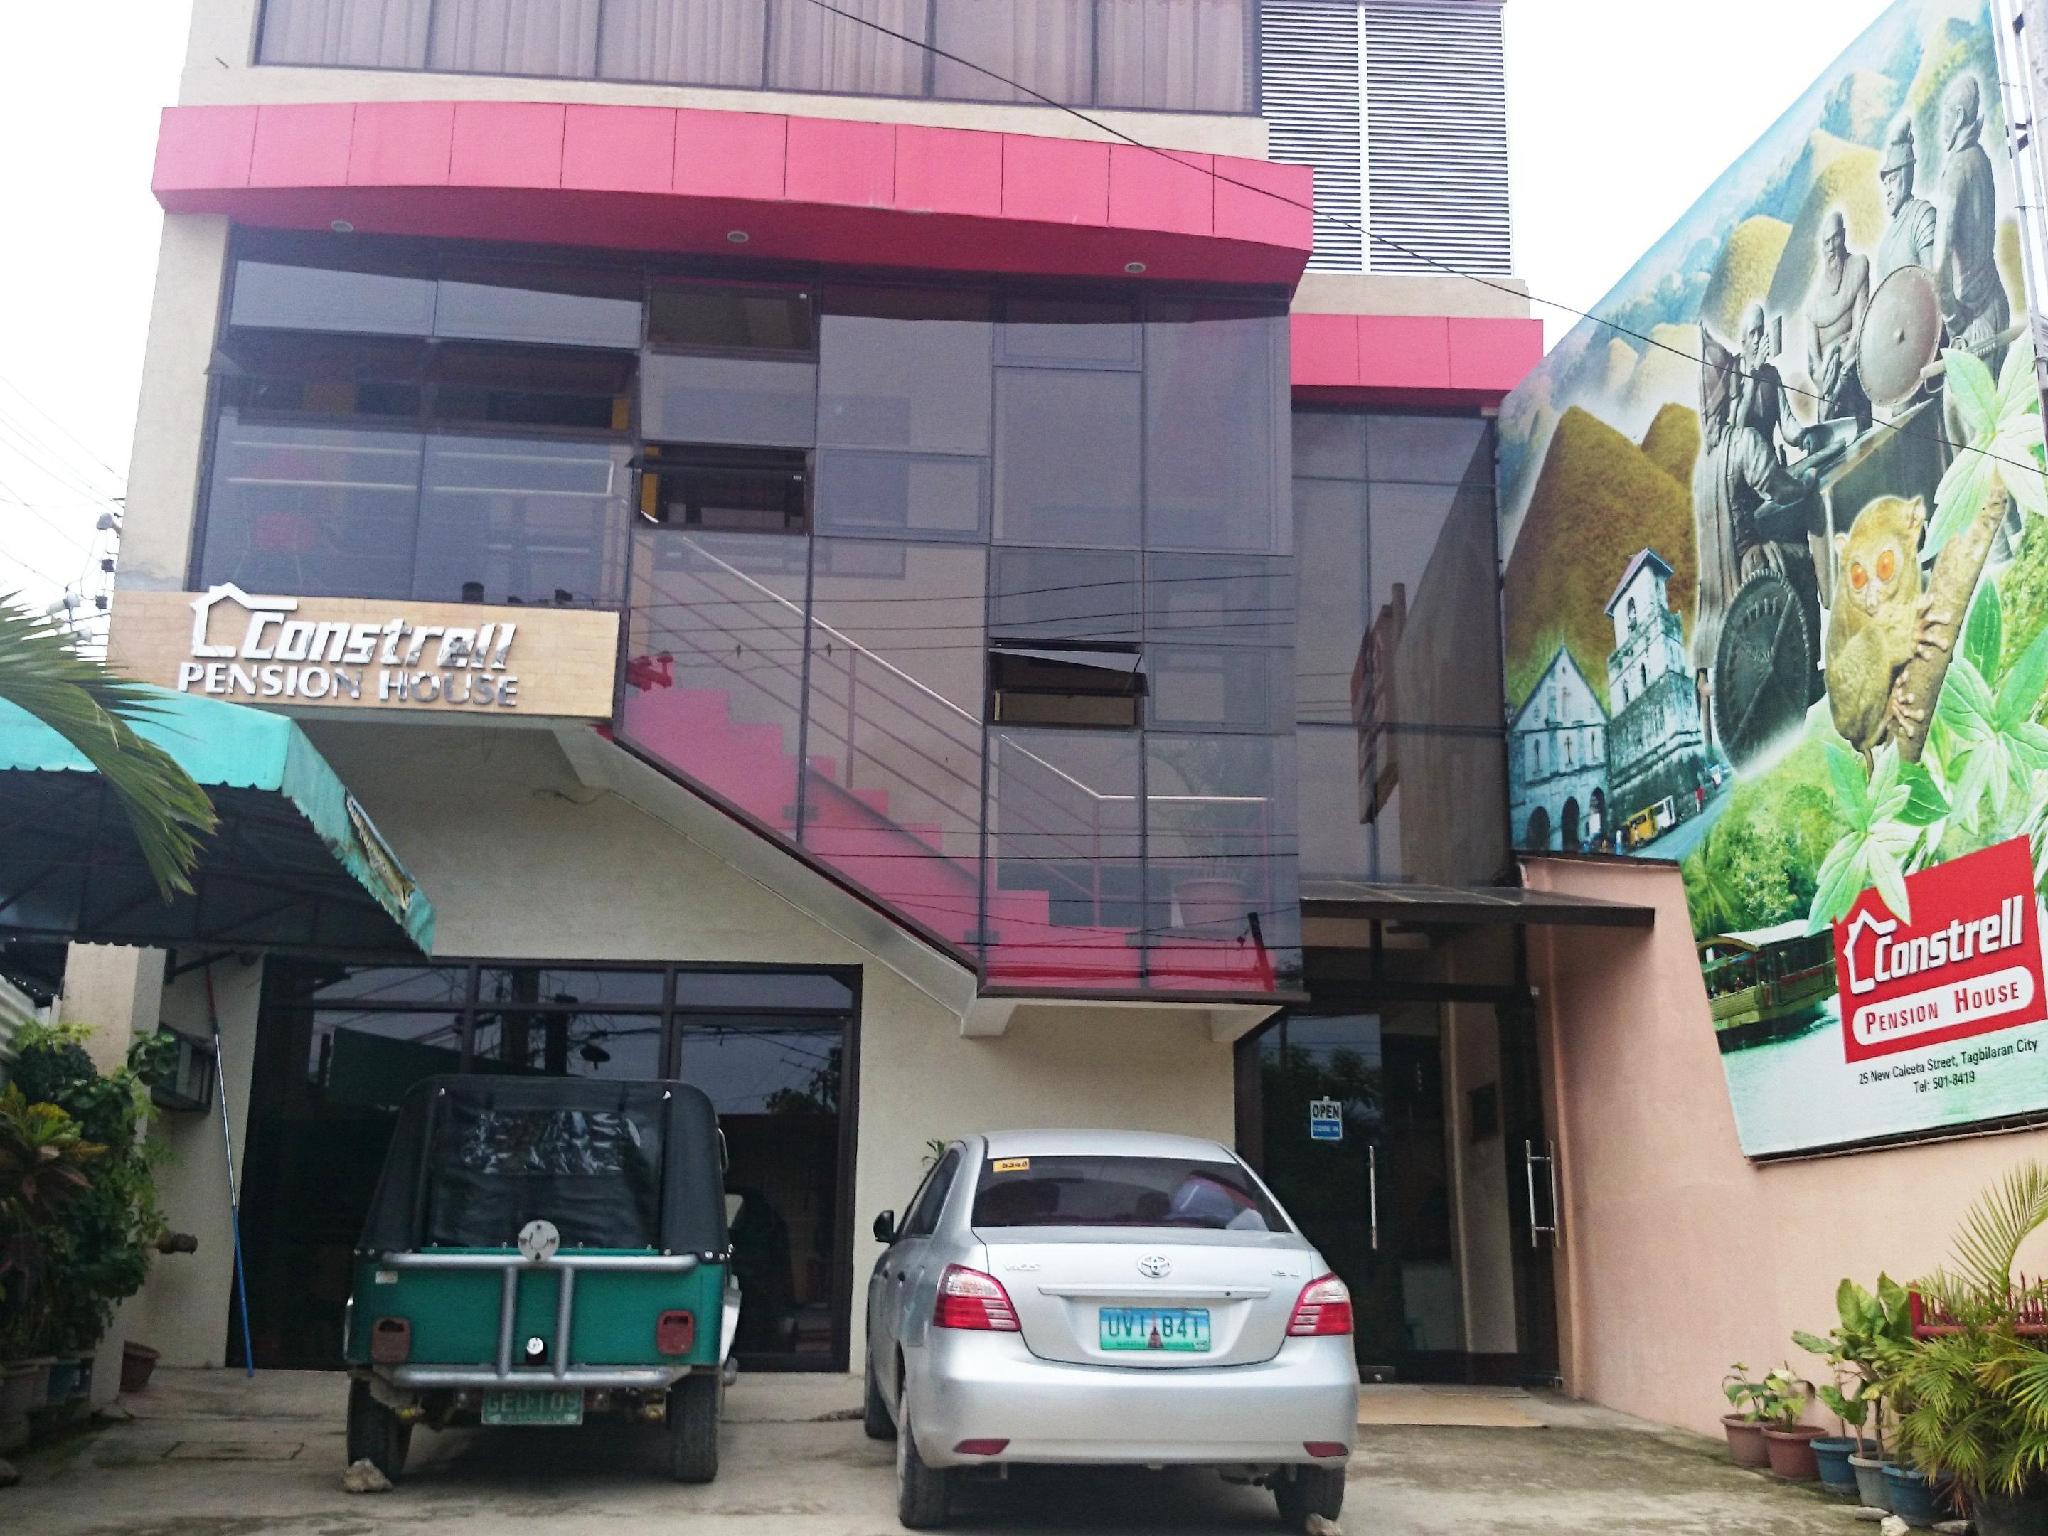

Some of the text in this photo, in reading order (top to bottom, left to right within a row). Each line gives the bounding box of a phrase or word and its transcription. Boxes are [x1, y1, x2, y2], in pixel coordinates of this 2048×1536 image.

[241, 611, 518, 670] Constrell
[177, 662, 519, 707] PENSION HOUSE
[1874, 895, 2023, 982] Constrell
[1865, 981, 2020, 1035] PENSION HOUSE
[1859, 1073, 1869, 1085] 25
[1871, 1069, 1890, 1082] New
[1961, 1045, 2014, 1065] Tagbilaran
[2016, 1038, 2038, 1053] City
[1312, 1104, 1341, 1119] OPEN
